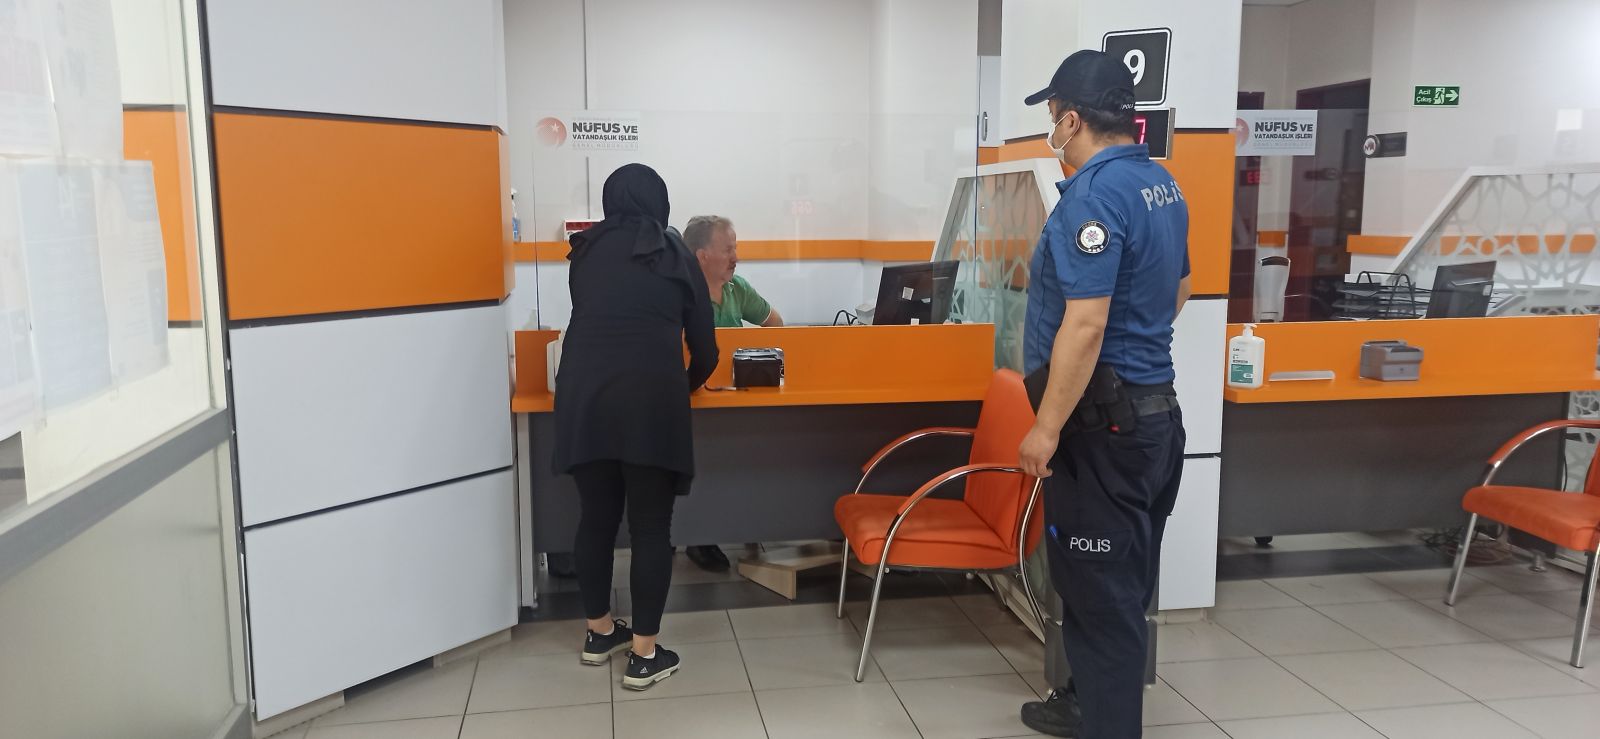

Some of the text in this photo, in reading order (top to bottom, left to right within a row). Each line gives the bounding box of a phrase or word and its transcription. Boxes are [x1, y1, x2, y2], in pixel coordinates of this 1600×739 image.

[1123, 49, 1146, 86] 9
[572, 122, 638, 133] NÜFUS VE
[1254, 121, 1314, 132] NÜFUS VE
